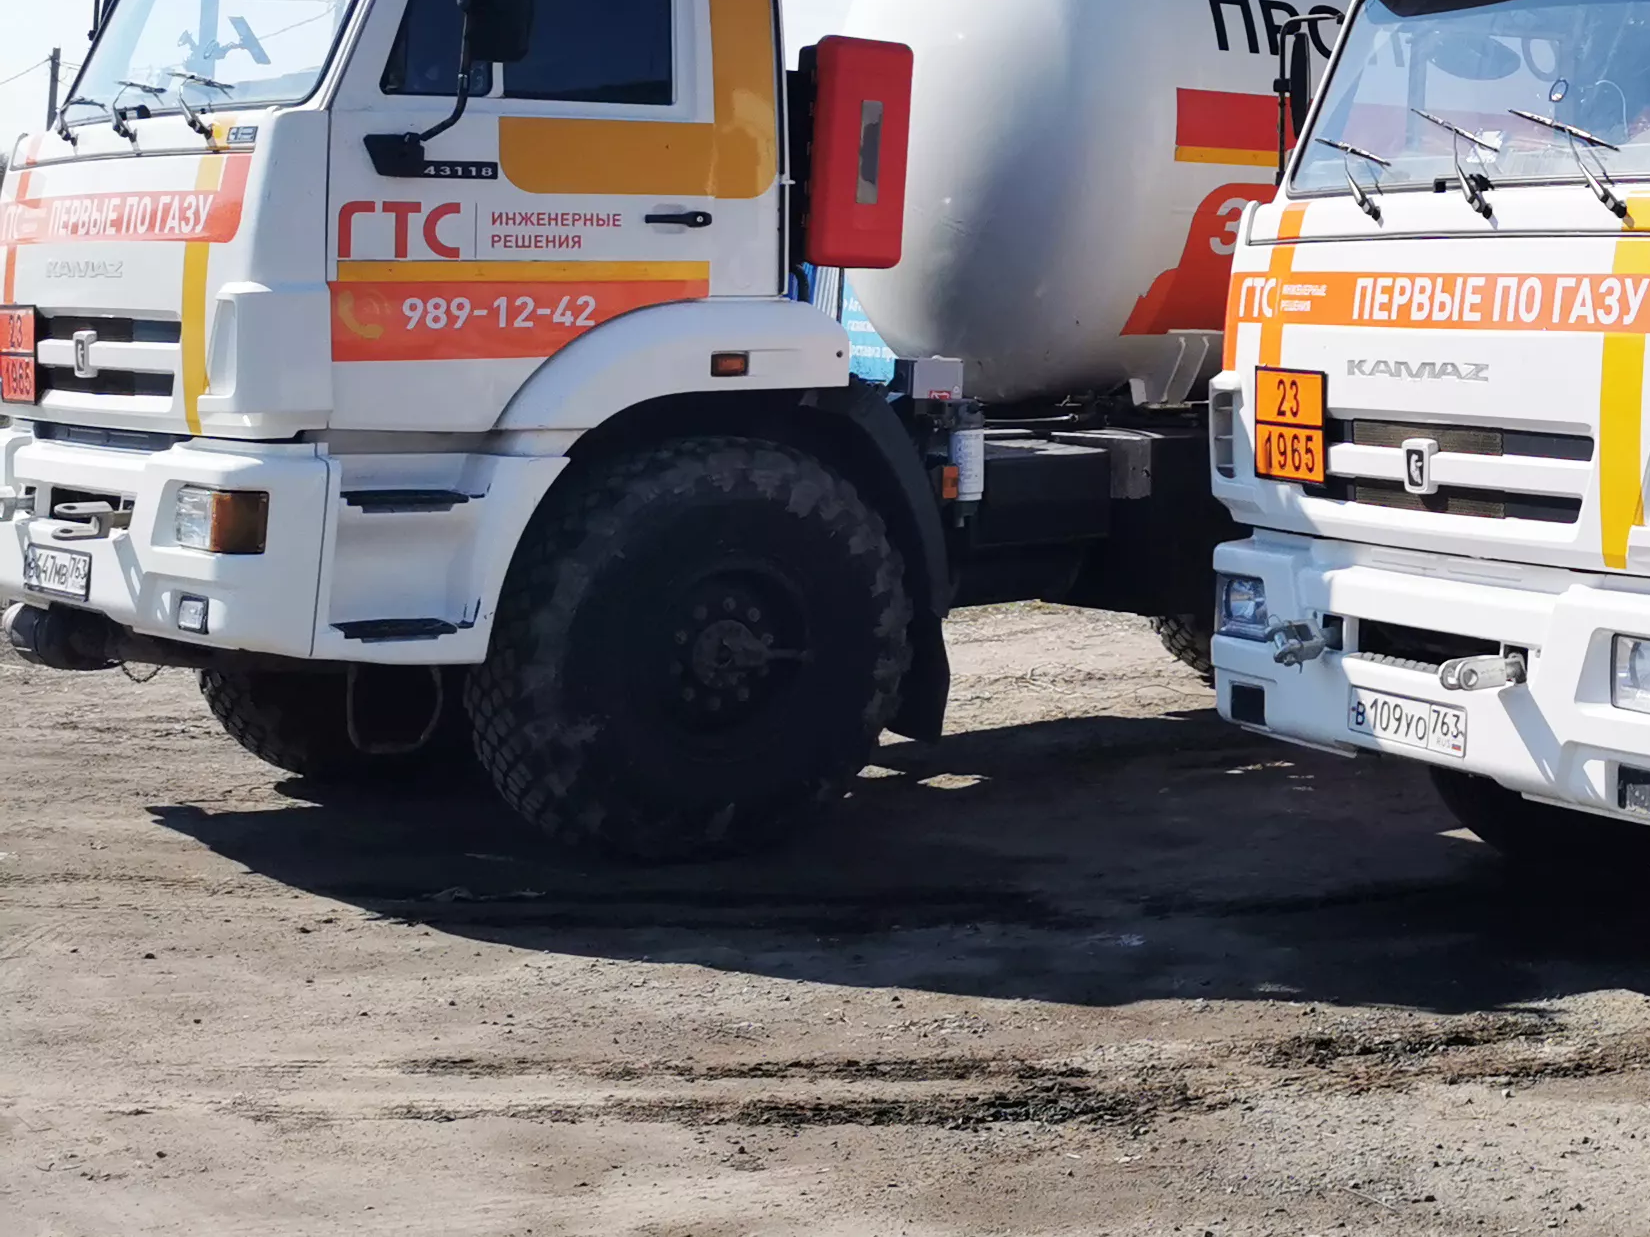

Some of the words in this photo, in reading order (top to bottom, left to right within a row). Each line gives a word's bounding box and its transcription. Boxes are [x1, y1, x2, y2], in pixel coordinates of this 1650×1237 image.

[424, 165, 493, 177] 43118
[50, 196, 121, 237] ПЕРВЫЕ
[121, 195, 152, 235] ПО
[154, 194, 214, 235] ГАЗУ
[337, 200, 461, 259] ГТС
[491, 211, 622, 228] ИНЖЕНЕРНЫЕ
[491, 234, 582, 250] РЕШЕНИЯ
[47, 259, 123, 278] KAMAZ
[402, 295, 597, 329] 989-12-42
[1239, 277, 1277, 317] ГТС
[1352, 277, 1486, 321] ПЕРВЫЕ
[1492, 277, 1543, 323] ПО
[1551, 278, 1650, 325] ГАЗУ
[9, 314, 23, 348] 23
[1347, 359, 1489, 382] KAMAZ
[1276, 379, 1300, 418] 23
[1264, 430, 1315, 473] 1965
[1432, 709, 1461, 739] 763
